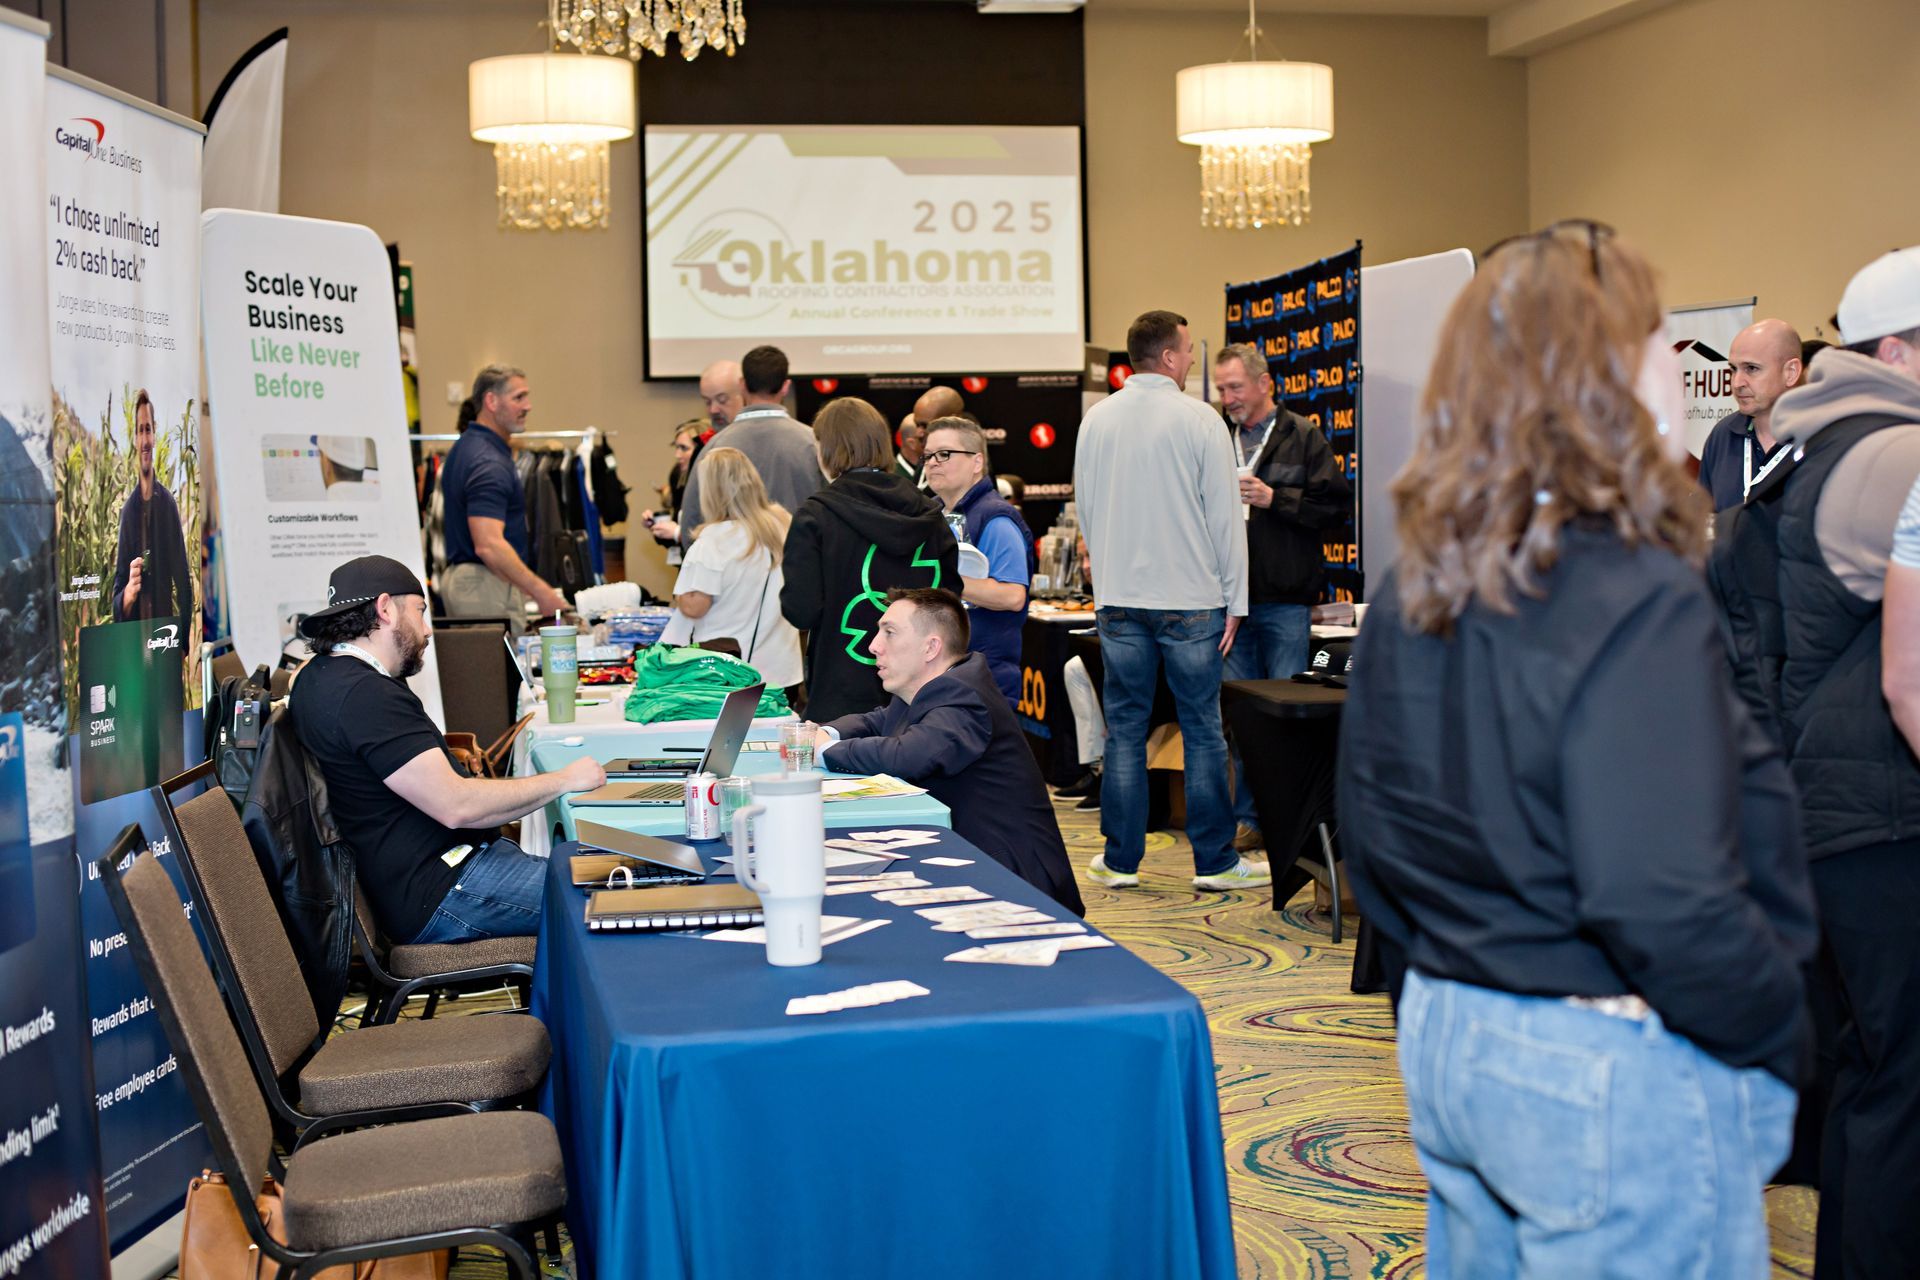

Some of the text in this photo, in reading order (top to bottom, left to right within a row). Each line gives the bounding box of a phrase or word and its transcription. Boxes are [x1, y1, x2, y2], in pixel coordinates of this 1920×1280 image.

[109, 146, 142, 173] Business
[65, 198, 101, 233] chose
[104, 211, 159, 247] unlimited
[914, 200, 1053, 233] 2025
[56, 239, 77, 269] 2%
[80, 246, 107, 275] cash
[717, 240, 1053, 284] Oklahoma
[244, 270, 358, 303] Scale Your
[757, 283, 1054, 299] ROOFING CONTRACTORS ASSOCIATION
[145, 311, 169, 327] create
[248, 304, 344, 334] Business
[790, 303, 1053, 320] Annual Conference & Trade Show
[250, 337, 361, 369] Like Never
[254, 372, 324, 400] Before
[1694, 368, 1733, 399] HUB
[267, 513, 359, 523] Customizable Workflows
[90, 717, 115, 736] SPARK
[90, 735, 115, 748] BUSINESS
[152, 835, 171, 858] Back
[90, 938, 103, 959] No
[5, 1005, 56, 1054] Rewards
[92, 1003, 129, 1037] Rewards
[129, 995, 150, 1019] that
[114, 1073, 156, 1100] employee
[156, 1053, 178, 1081] cards
[31, 1191, 91, 1251] worldwide
